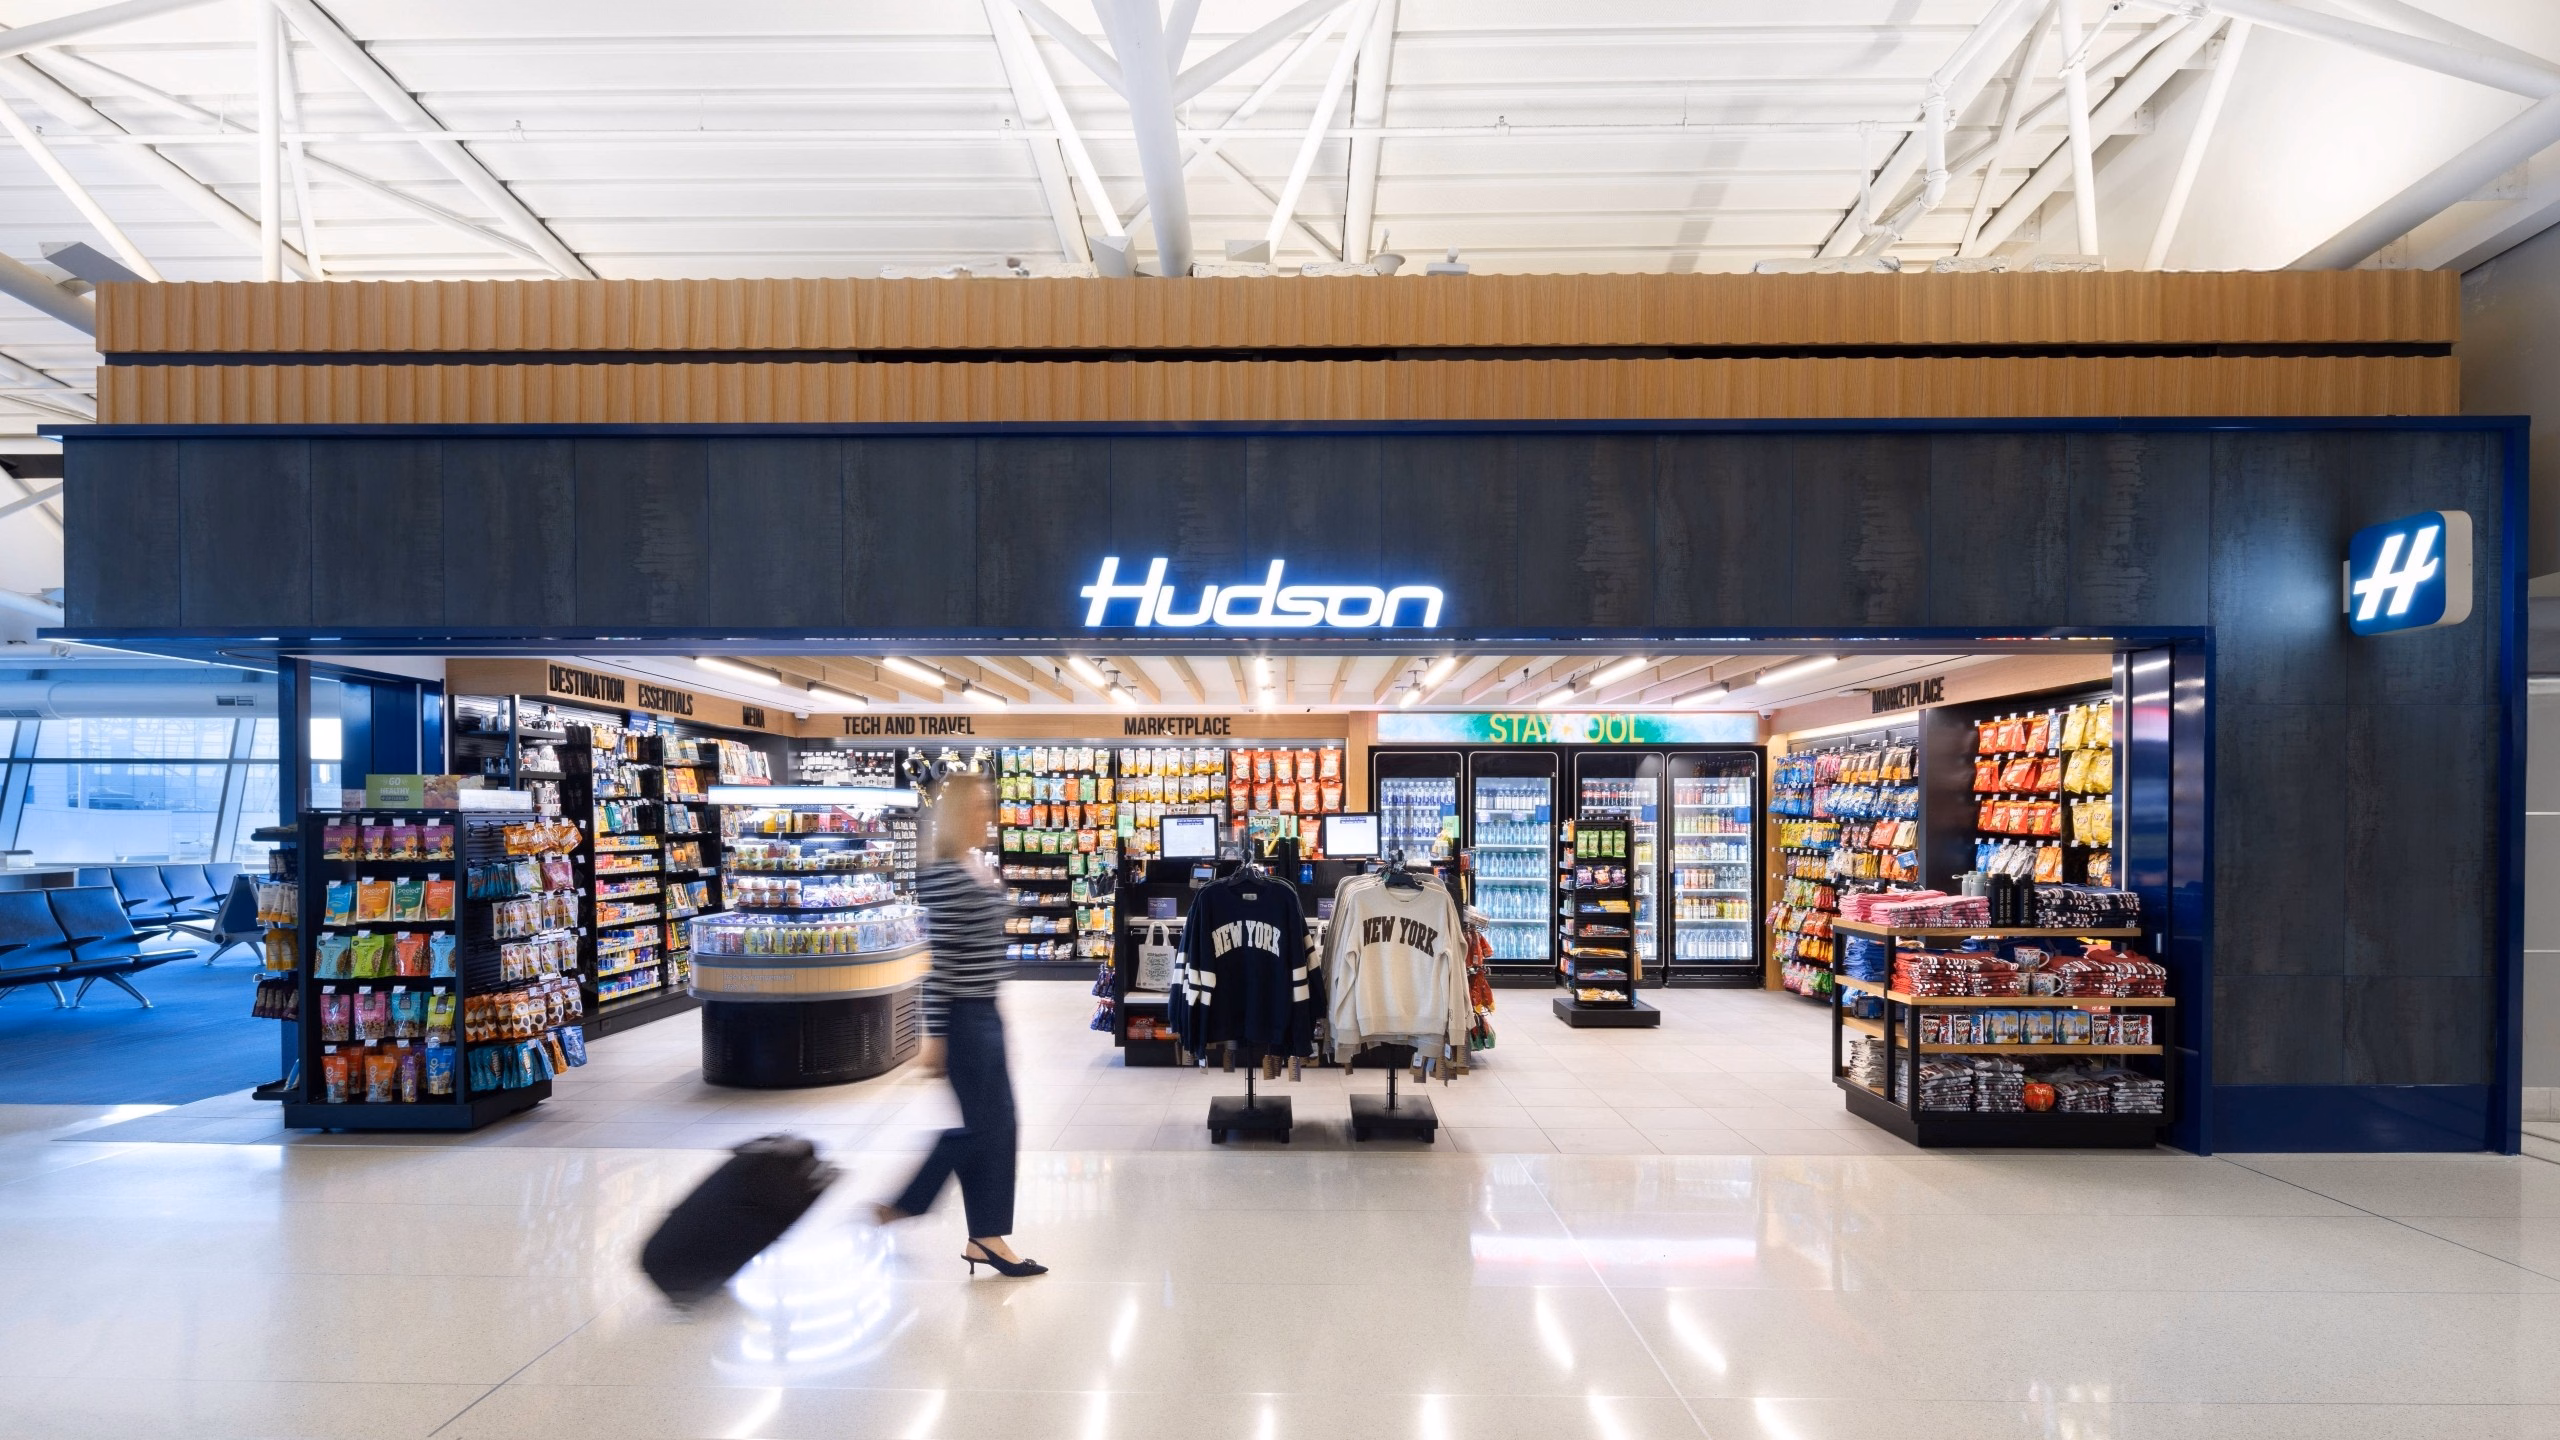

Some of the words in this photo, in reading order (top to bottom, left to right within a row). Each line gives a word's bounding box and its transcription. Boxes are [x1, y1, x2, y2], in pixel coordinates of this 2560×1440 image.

[1080, 557, 1444, 627] Hudson
[550, 664, 625, 703] DESTINATION
[638, 683, 694, 716] ESSENTIALS
[1872, 676, 1945, 714] MARKETPLACE
[742, 705, 765, 729] MEDIA
[843, 716, 882, 735] TECH
[884, 716, 916, 735] AND
[919, 716, 975, 735] TRAVEL
[1124, 716, 1231, 735] MARKETPLACE
[1489, 713, 1554, 744] STAY
[1584, 713, 1645, 744] OOL
[363, 886, 388, 896] peeled
[397, 886, 420, 896] peeled
[1212, 920, 1243, 958] NEW
[1245, 919, 1281, 958] YORK
[1363, 915, 1395, 947] NEW
[1400, 917, 1438, 957] YORK
